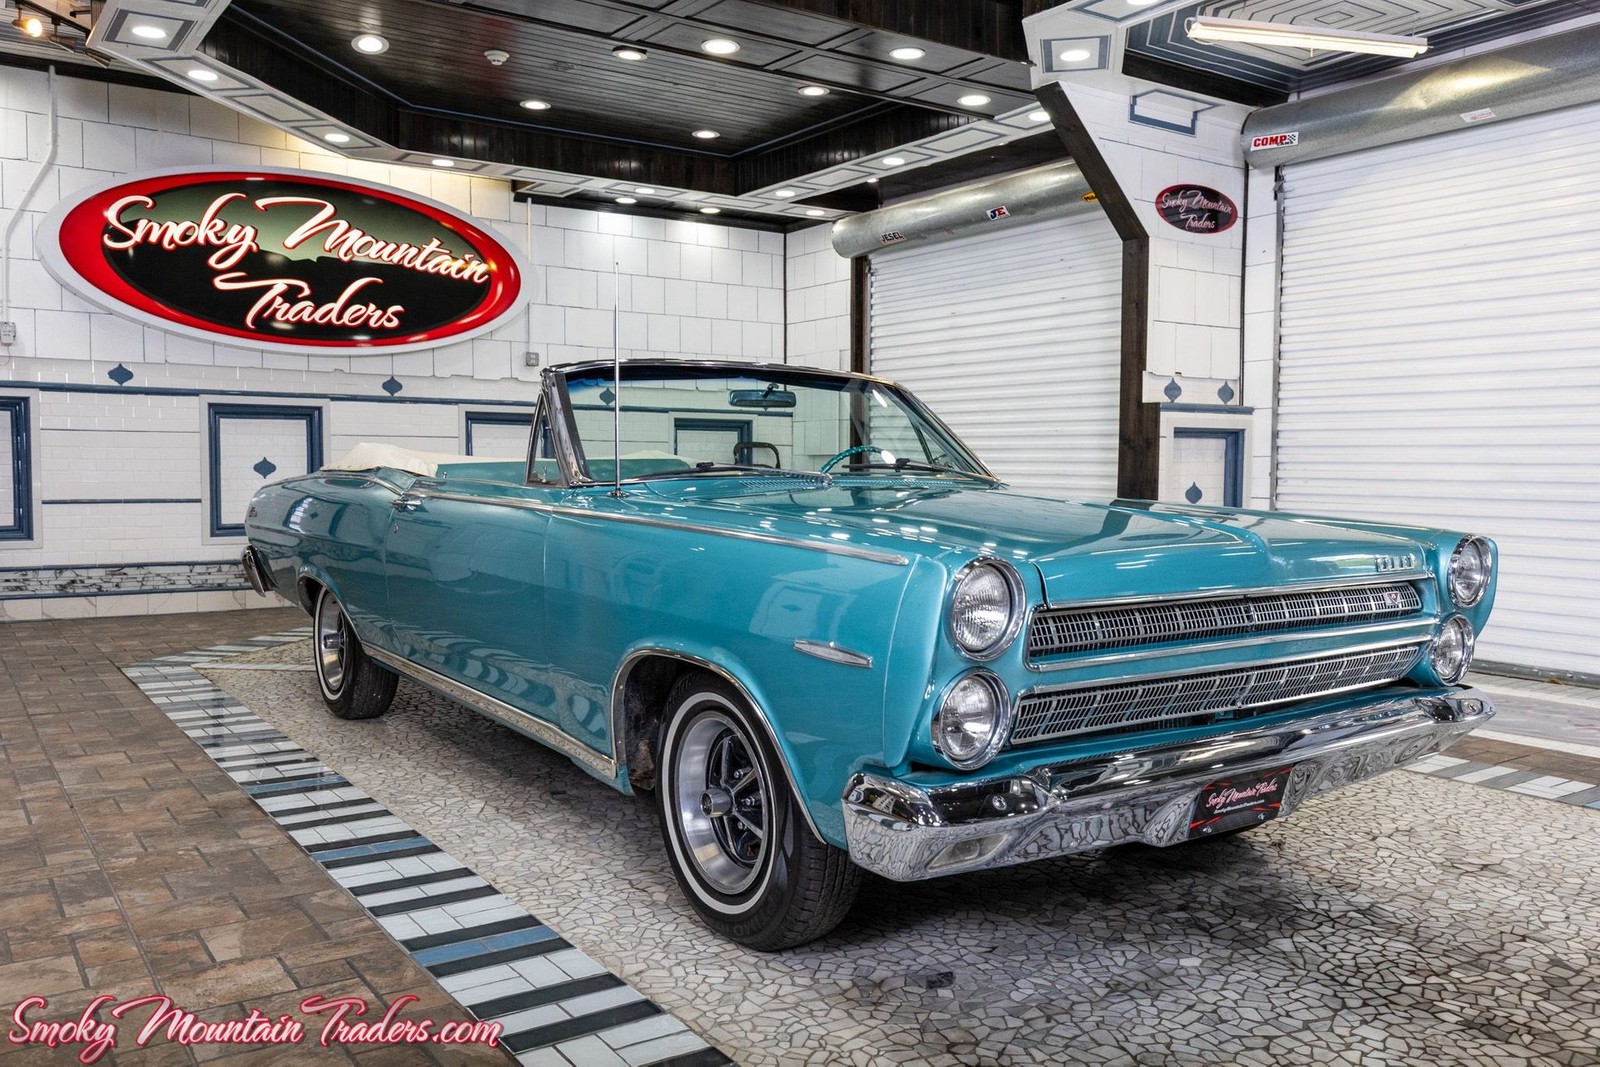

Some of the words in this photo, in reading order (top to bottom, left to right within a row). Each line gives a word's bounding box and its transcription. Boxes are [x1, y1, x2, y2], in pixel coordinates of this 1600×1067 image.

[1253, 135, 1287, 147] COMP
[1161, 190, 1188, 213] Smoky
[1186, 189, 1232, 214] Mountain
[990, 206, 1006, 219] JE
[1180, 213, 1216, 230] Traders
[102, 193, 259, 270] Smoky
[255, 196, 492, 283] Mountain
[881, 231, 904, 243] JESEL
[213, 272, 405, 329] Traders
